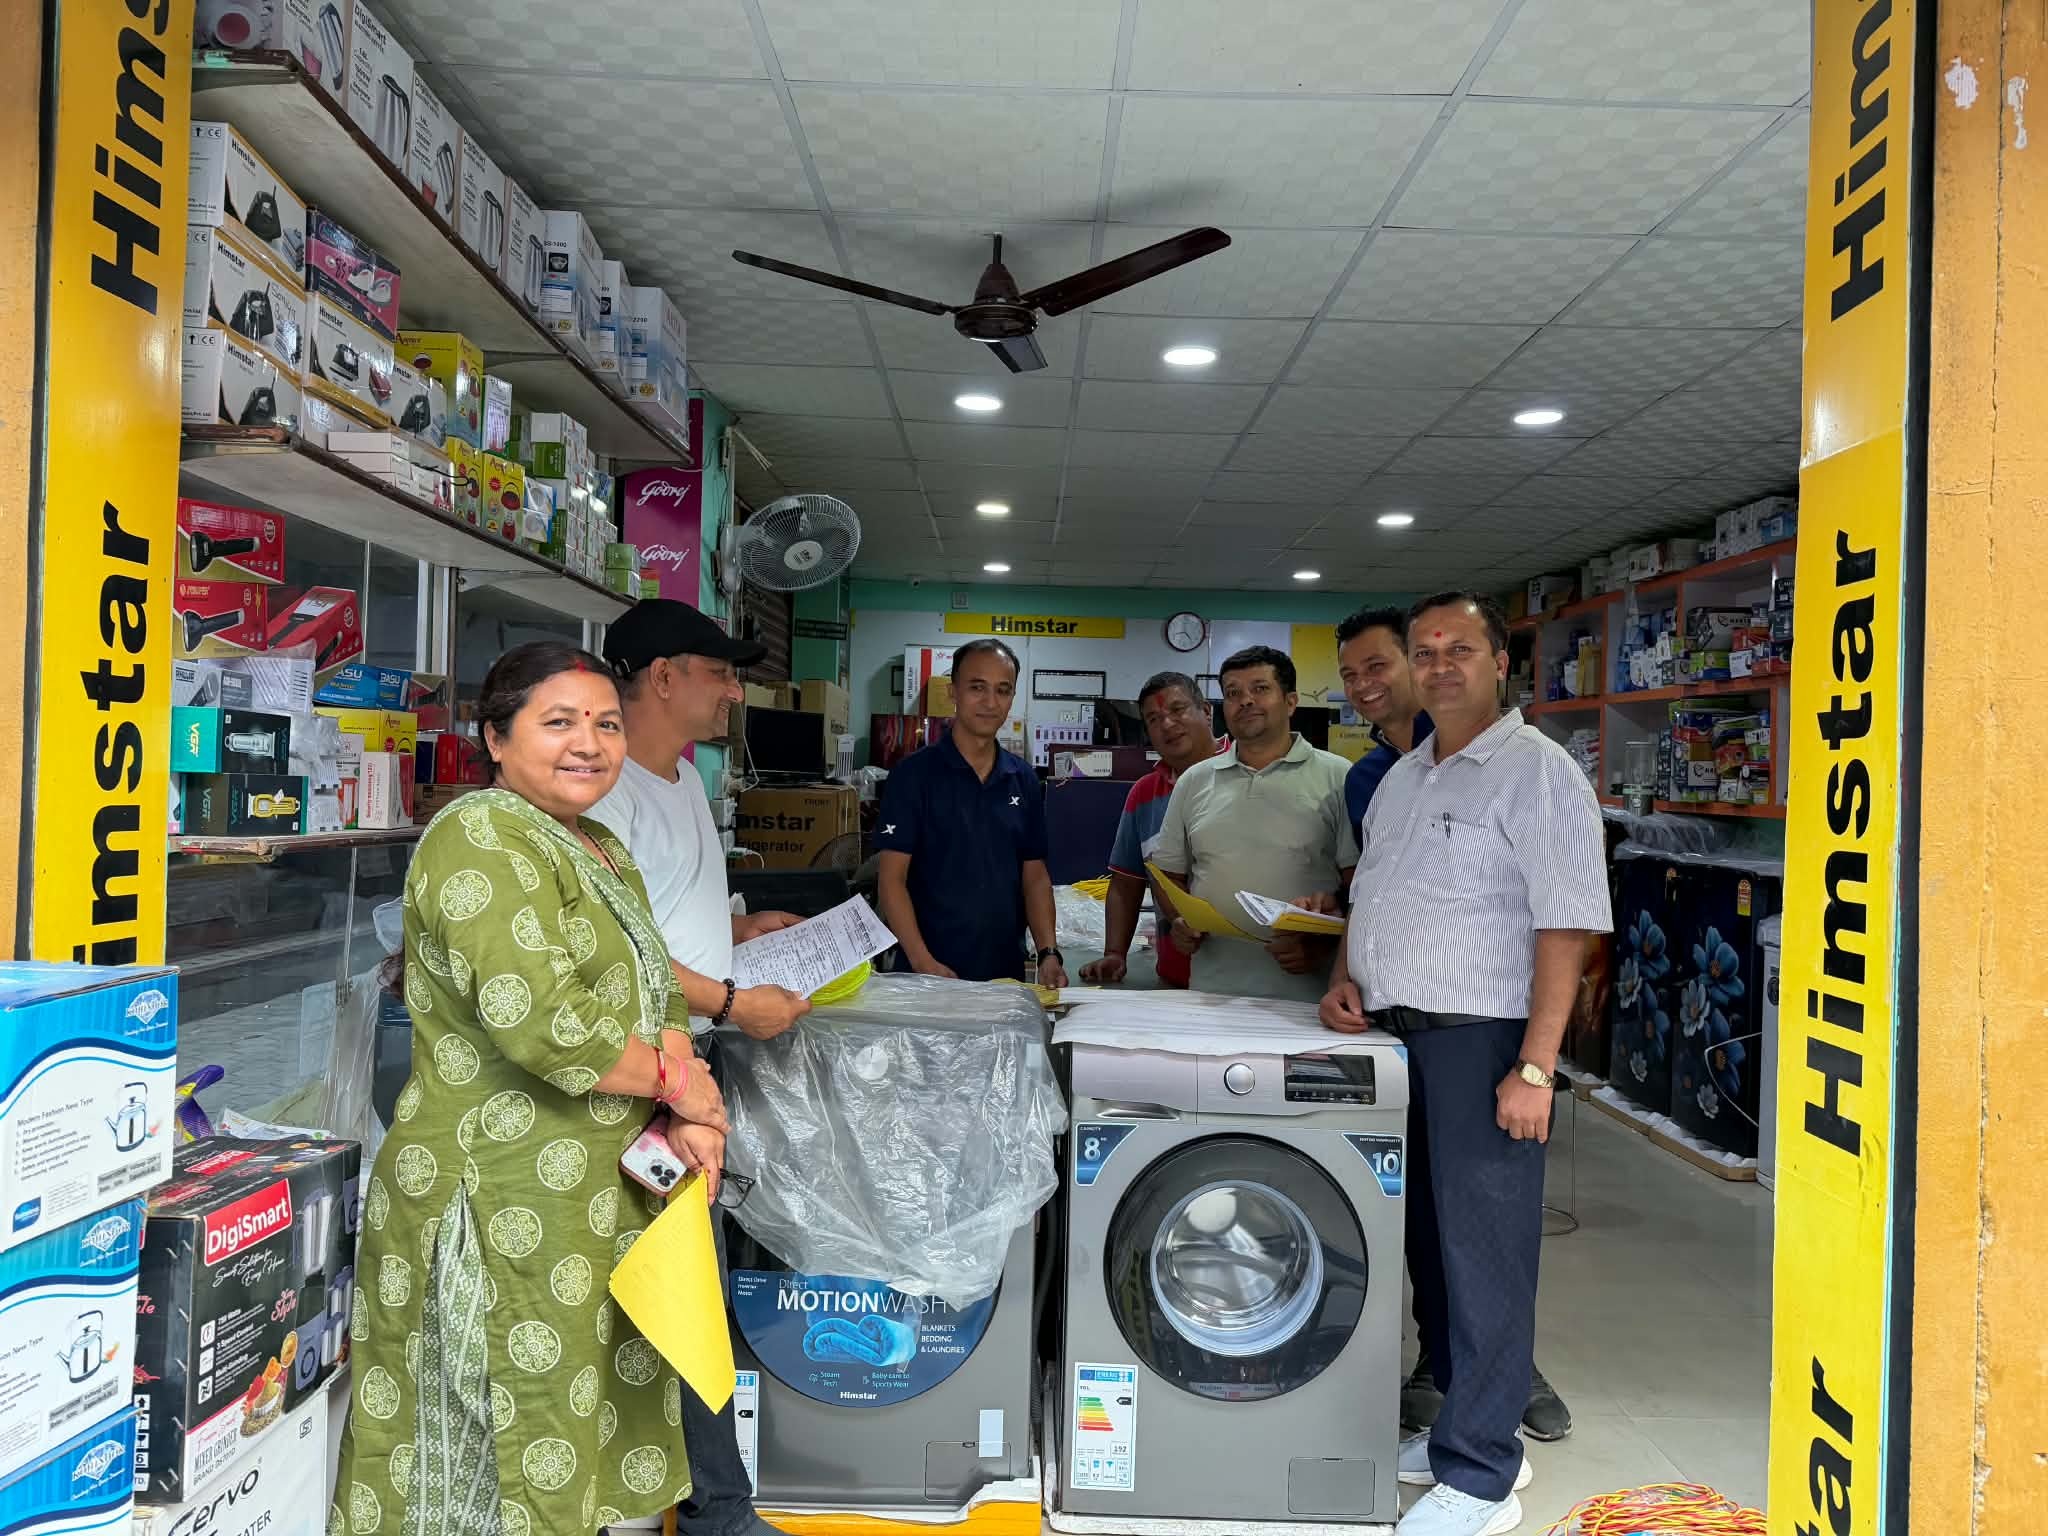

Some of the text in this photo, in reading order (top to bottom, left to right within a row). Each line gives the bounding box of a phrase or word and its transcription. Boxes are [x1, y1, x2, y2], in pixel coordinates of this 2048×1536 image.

[232, 138, 256, 168] Himstar
[1831, 0, 1892, 322] Him
[217, 241, 245, 270] Himstar
[320, 305, 343, 328] Himstar
[227, 343, 255, 368] Himstar
[636, 480, 691, 507] Godrej
[639, 545, 690, 571] Godrej
[991, 616, 1078, 634] Himstar
[72, 500, 149, 966] imstar
[190, 722, 199, 757] VGR
[202, 788, 212, 822] VGR
[1804, 529, 1876, 1157] Himstar
[80, 1097, 94, 1109] Type
[1084, 1137, 1100, 1161] 8
[1373, 1152, 1399, 1175] 10
[207, 1198, 289, 1256] DigiSmart
[779, 1278, 808, 1290] Direct
[921, 1335, 952, 1343] BEDDING
[926, 1346, 965, 1354] LAUNDRIES
[820, 1370, 840, 1379] Steam
[871, 1372, 886, 1380] Baby
[872, 1381, 891, 1389] Sports
[840, 1391, 877, 1400] Himstar
[1113, 1445, 1127, 1453] 192
[1795, 1354, 1853, 1536] ar
[194, 1446, 213, 1473] MIXER
